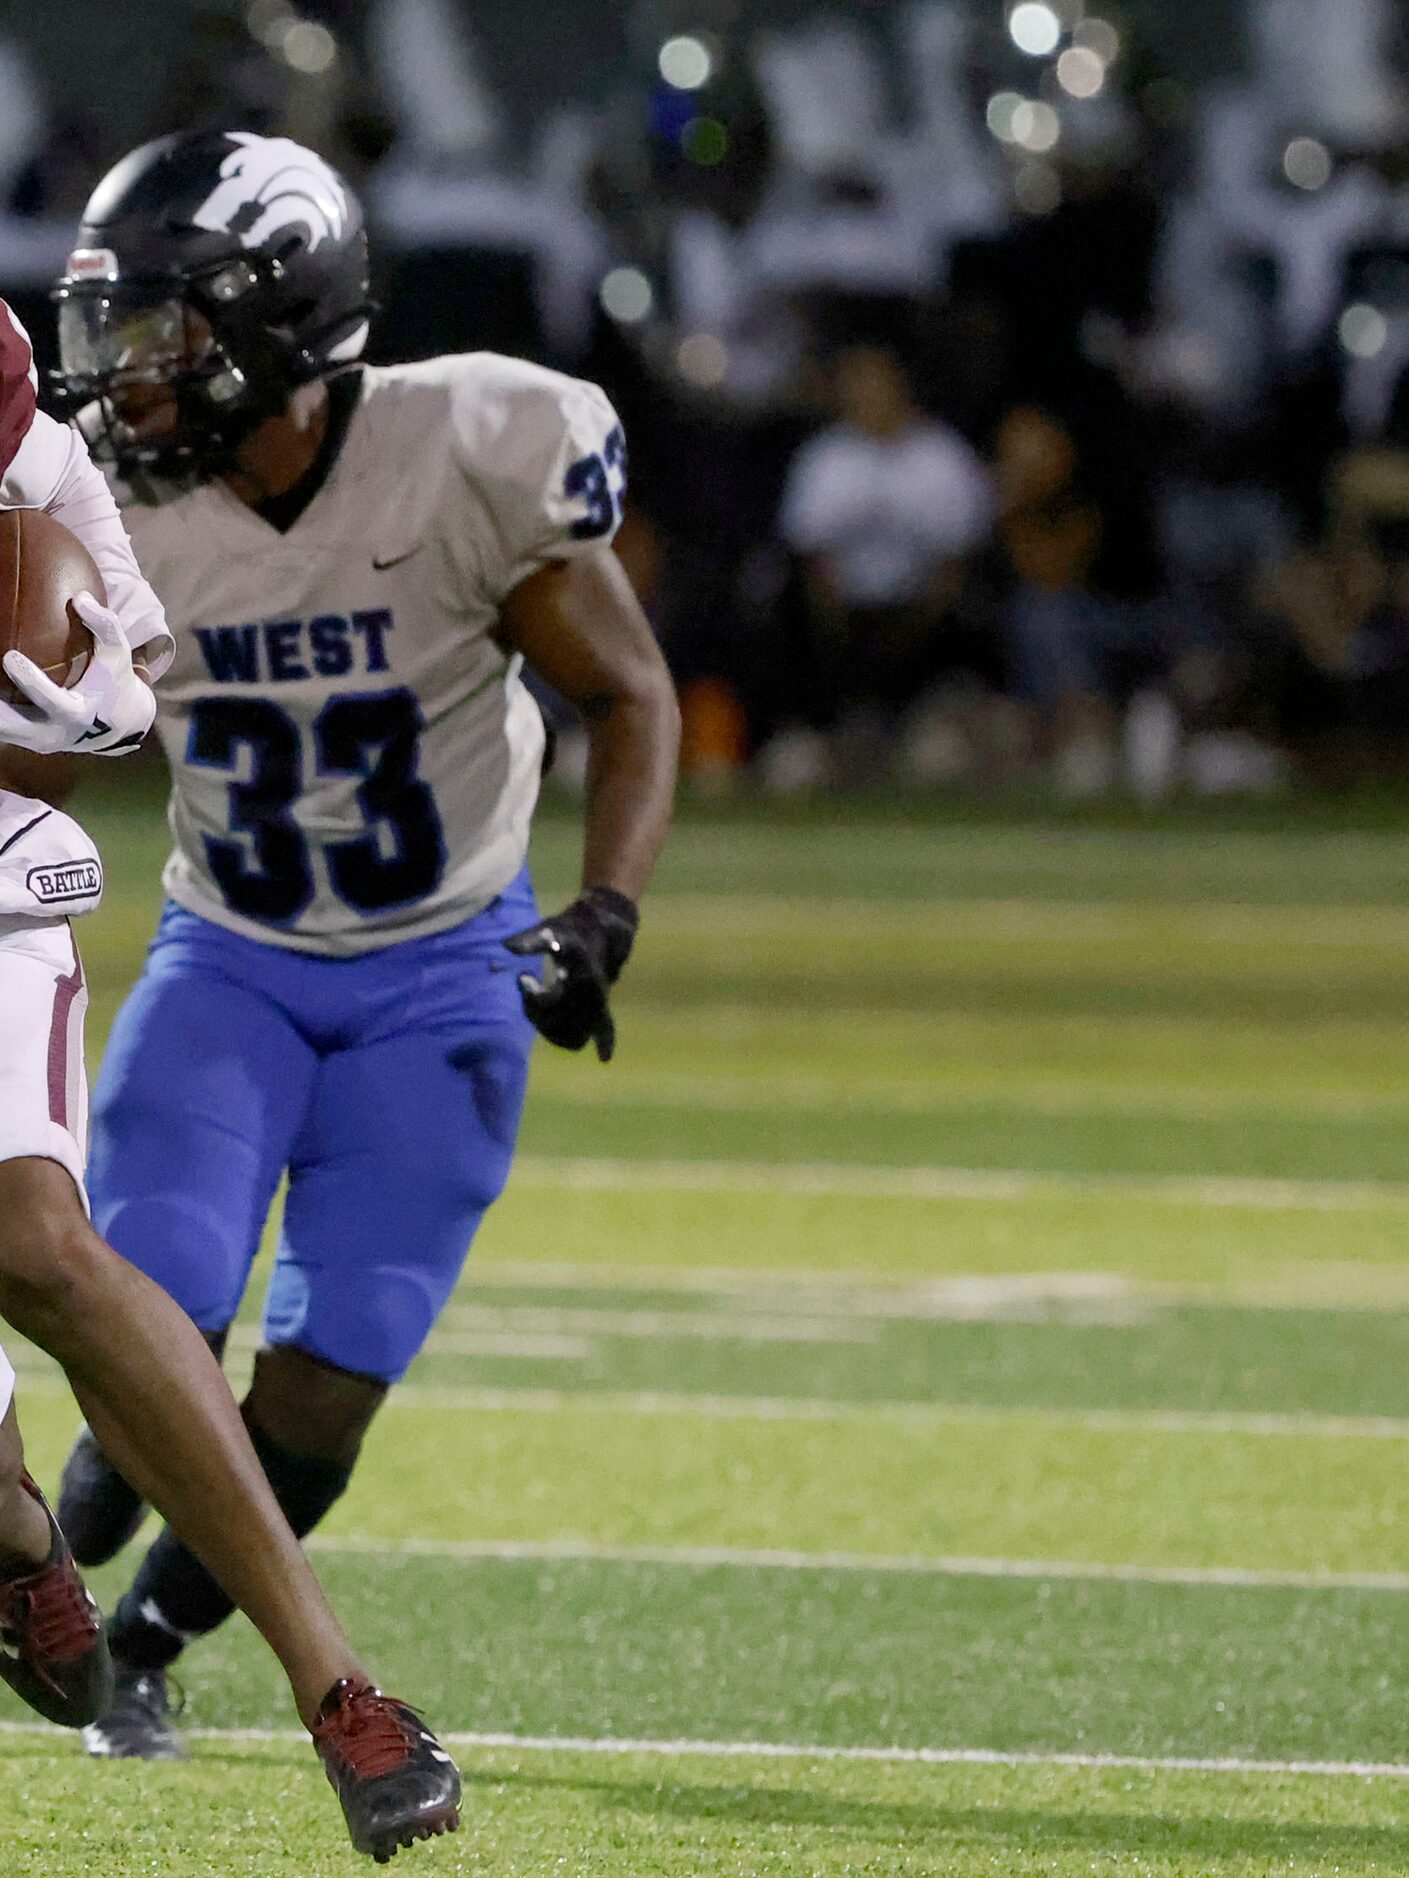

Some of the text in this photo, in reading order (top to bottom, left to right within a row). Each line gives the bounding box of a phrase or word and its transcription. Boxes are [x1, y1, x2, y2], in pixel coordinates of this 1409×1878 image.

[194, 608, 393, 683] WEST
[185, 684, 449, 931] 33
[36, 867, 97, 895] BATTLE
